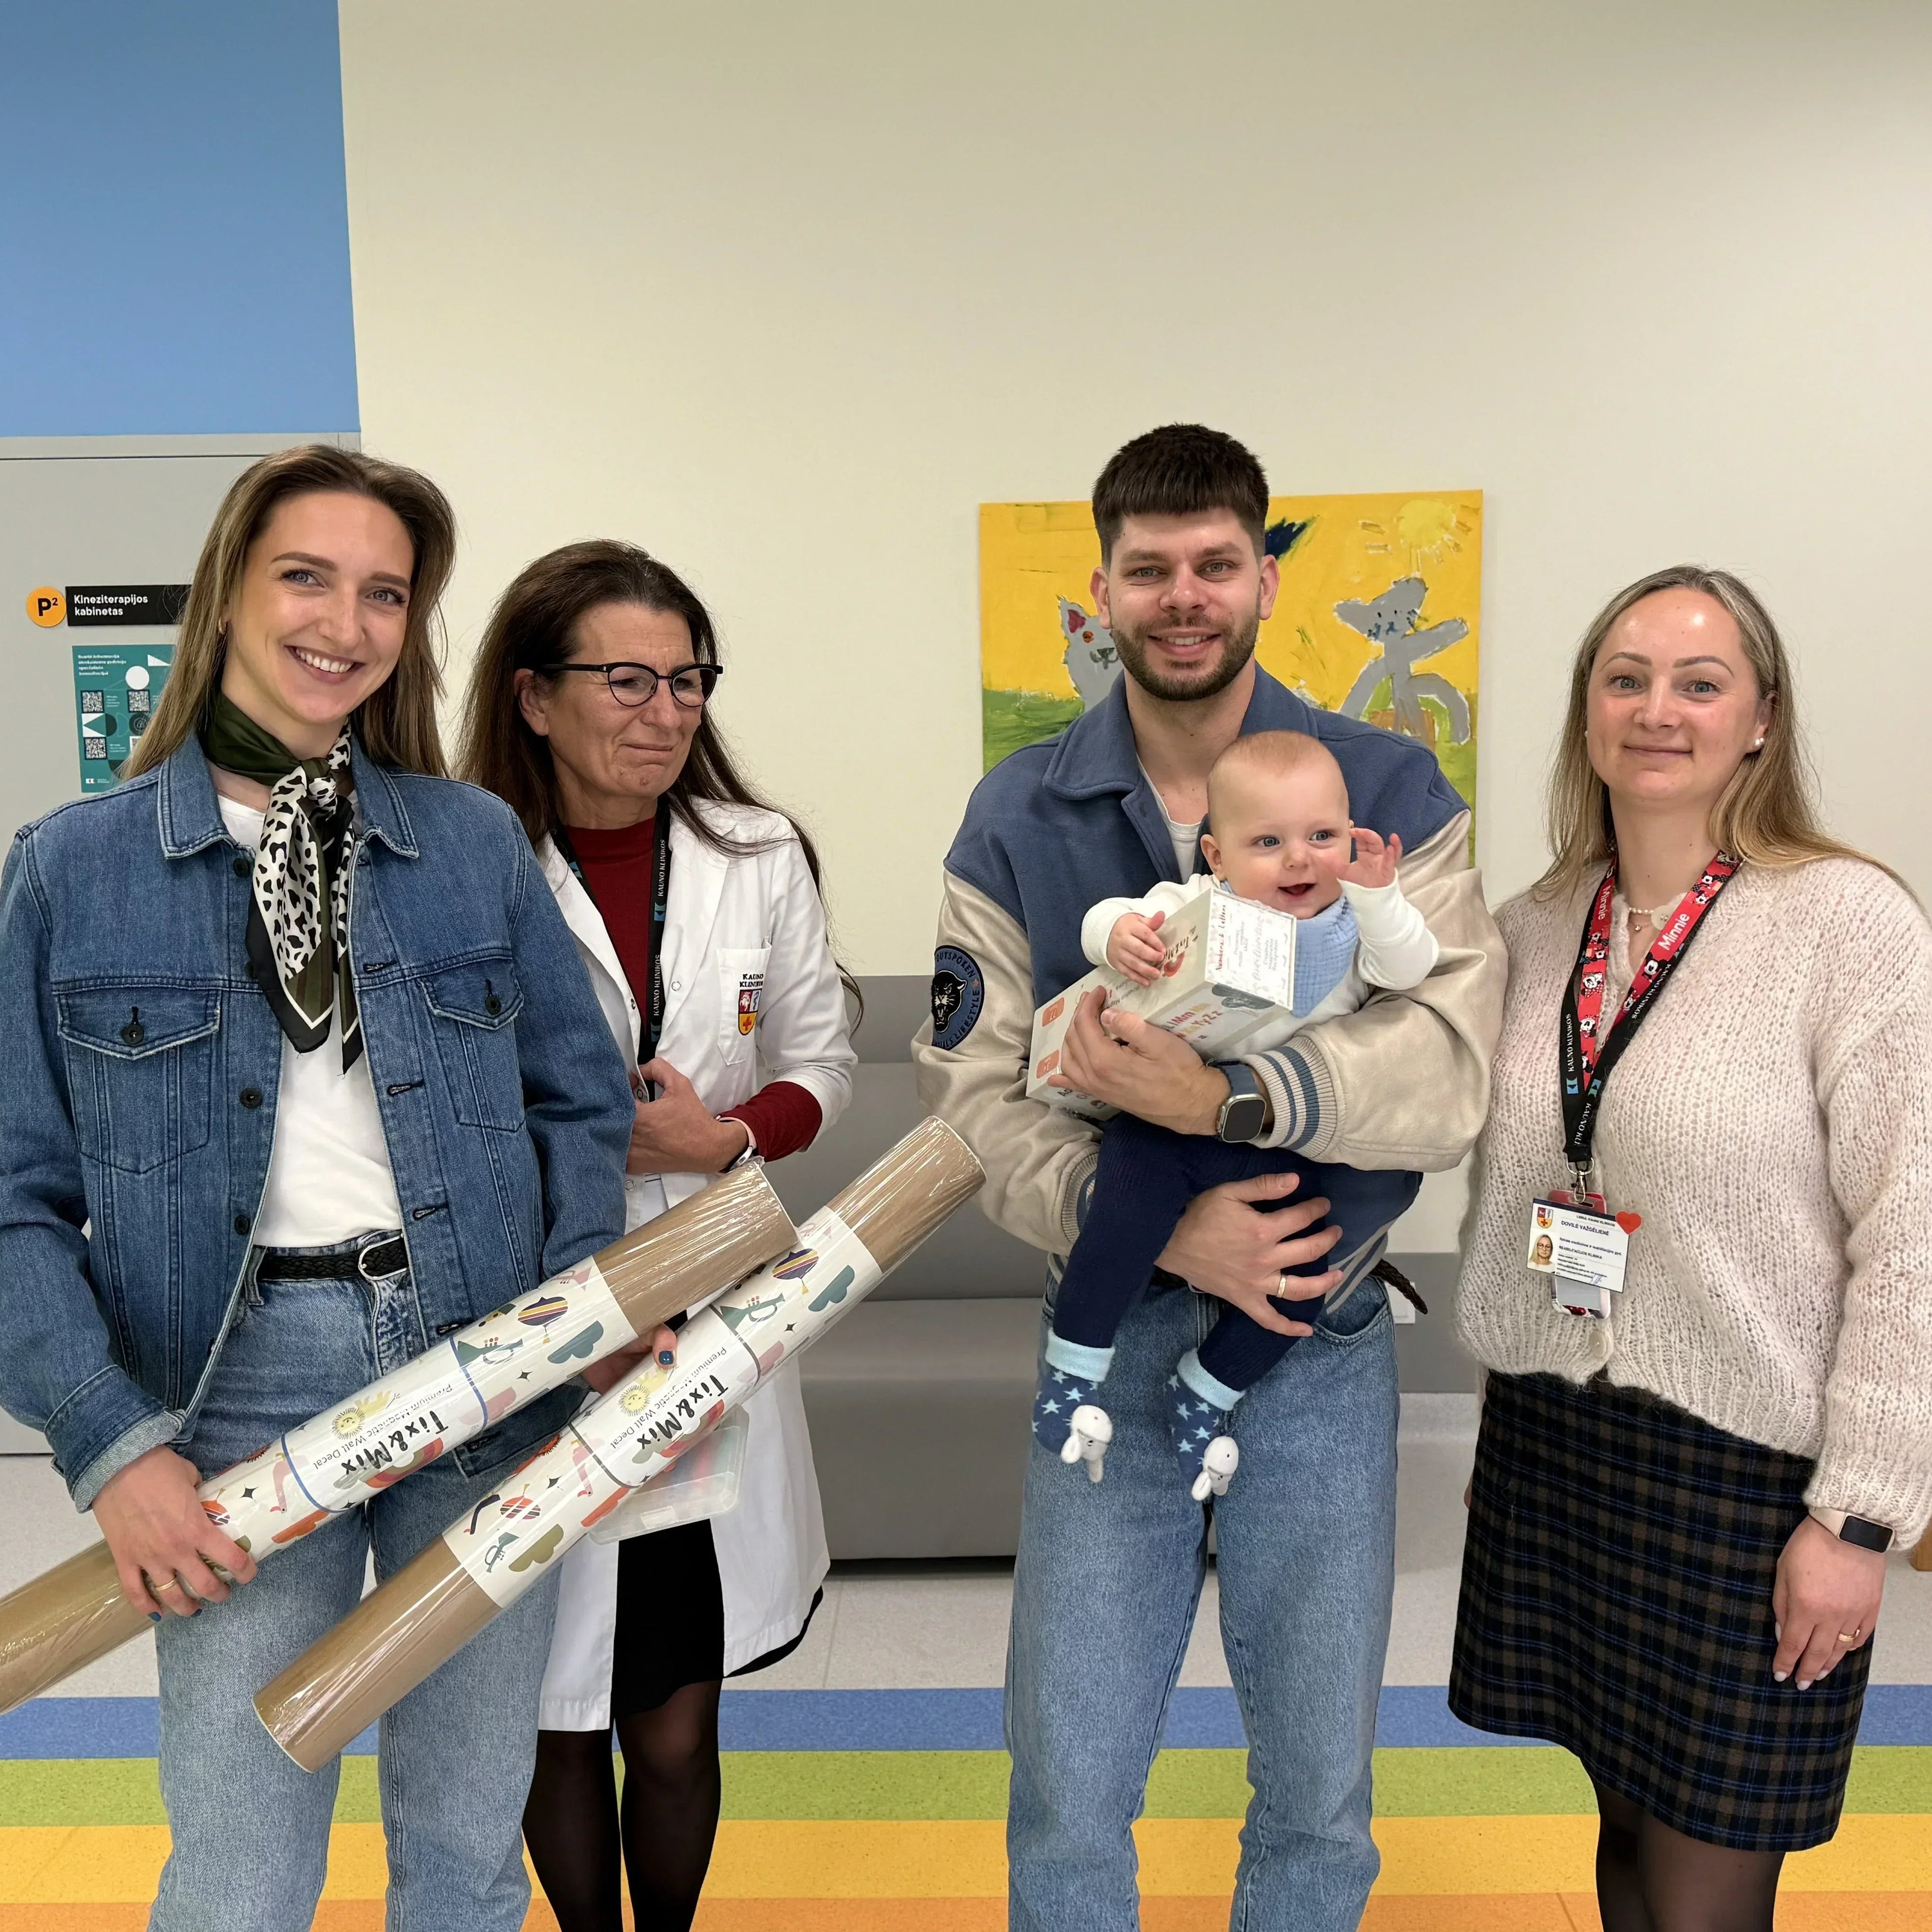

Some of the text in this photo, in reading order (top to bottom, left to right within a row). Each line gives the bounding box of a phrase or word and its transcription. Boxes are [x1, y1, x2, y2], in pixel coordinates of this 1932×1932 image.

[74, 594, 148, 605] Kineziterapijos
[75, 607, 123, 616] kabinetas
[1598, 885, 1611, 920] Minnie
[1657, 913, 1690, 951] Minnie
[937, 951, 976, 978] OUTSPOKEN
[954, 989, 980, 1041] LIFESTYLE
[1632, 989, 1656, 1019] KLINIKOS
[1578, 1103, 1592, 1131] KAUNO
[691, 1346, 727, 1377] Premium
[634, 1409, 656, 1428] Wall
[637, 1375, 728, 1450] Tix&Mix
[341, 1410, 448, 1475] Tix&Mix
[342, 1435, 366, 1452] Wall
[610, 1426, 635, 1448] Decal
[313, 1449, 341, 1469] Decal
